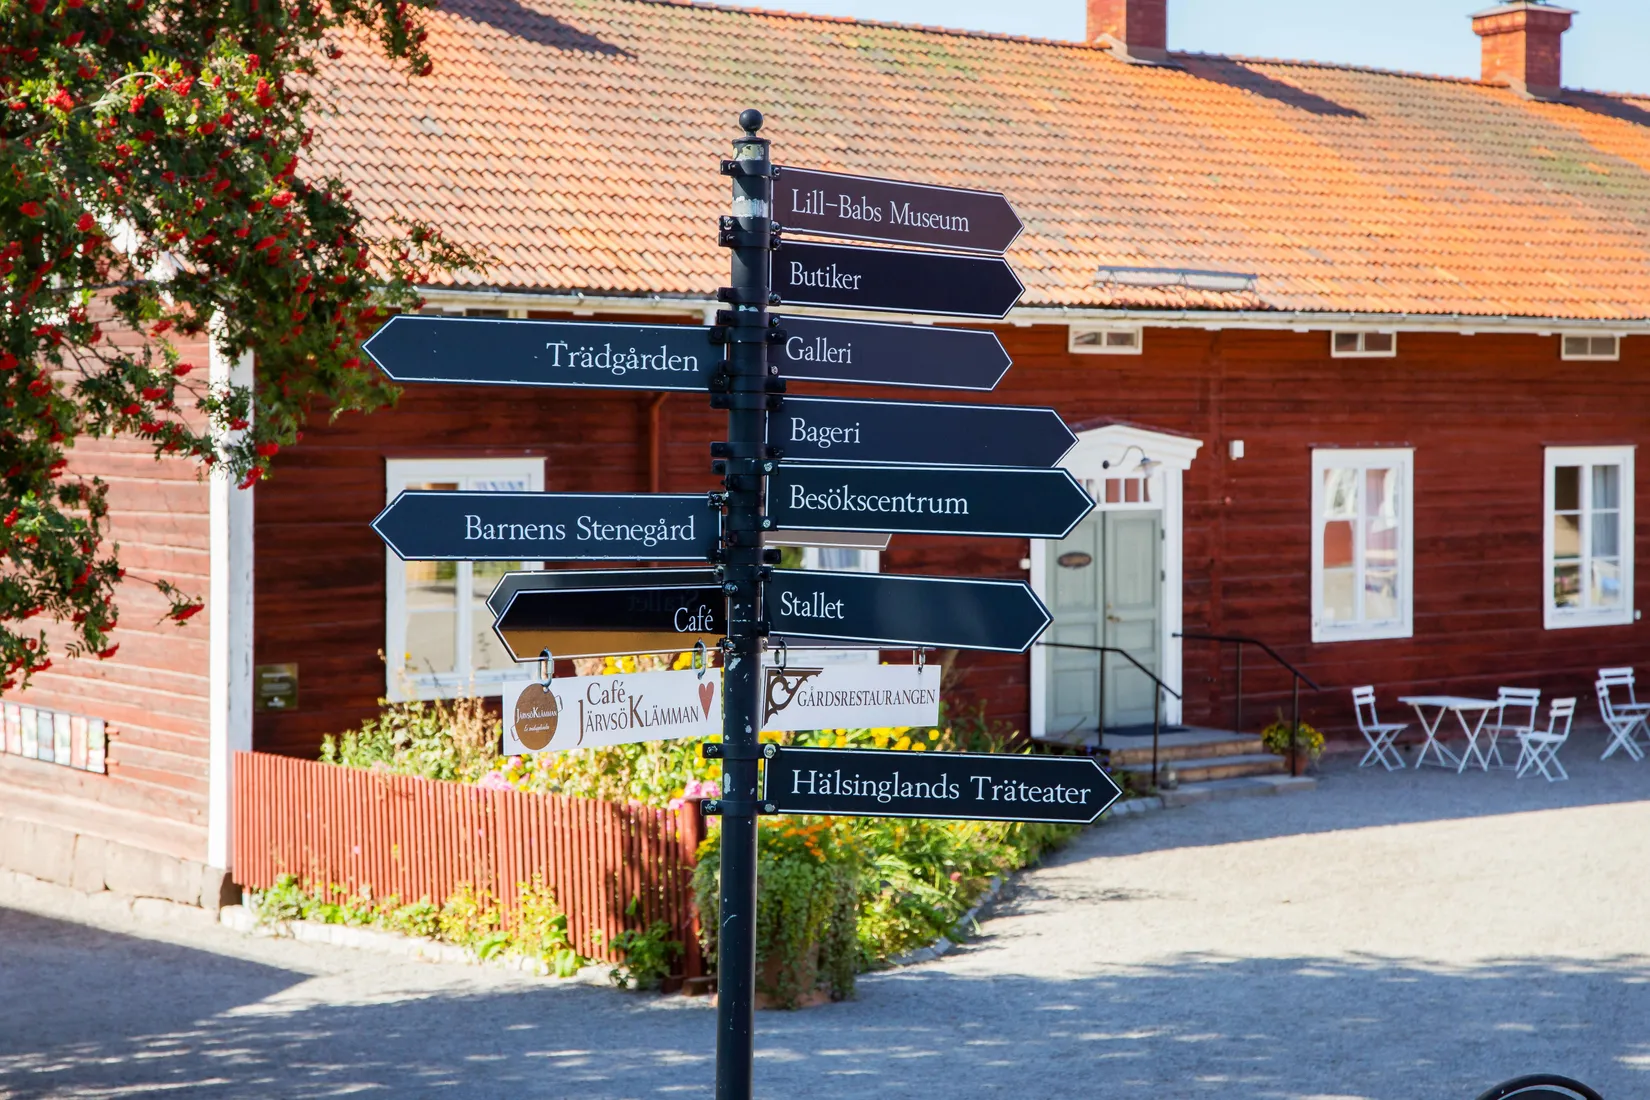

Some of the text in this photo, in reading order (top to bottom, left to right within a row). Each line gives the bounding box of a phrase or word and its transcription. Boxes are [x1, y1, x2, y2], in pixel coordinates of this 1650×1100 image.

[792, 189, 970, 232] Lill-Babs Museum
[790, 262, 861, 289] Butiker
[546, 341, 699, 375] Trädgården
[786, 336, 851, 363] Galleri
[790, 418, 860, 448] Bageri
[789, 485, 969, 514] Besökscentrum
[465, 515, 695, 547] Barnens Stenegård
[673, 604, 714, 632] Café
[781, 591, 844, 619] Stallet
[586, 679, 626, 706] Café
[797, 685, 936, 708] GÅRDSRESTAURANGEN
[791, 769, 1091, 804] Hälsinglands Träteater
